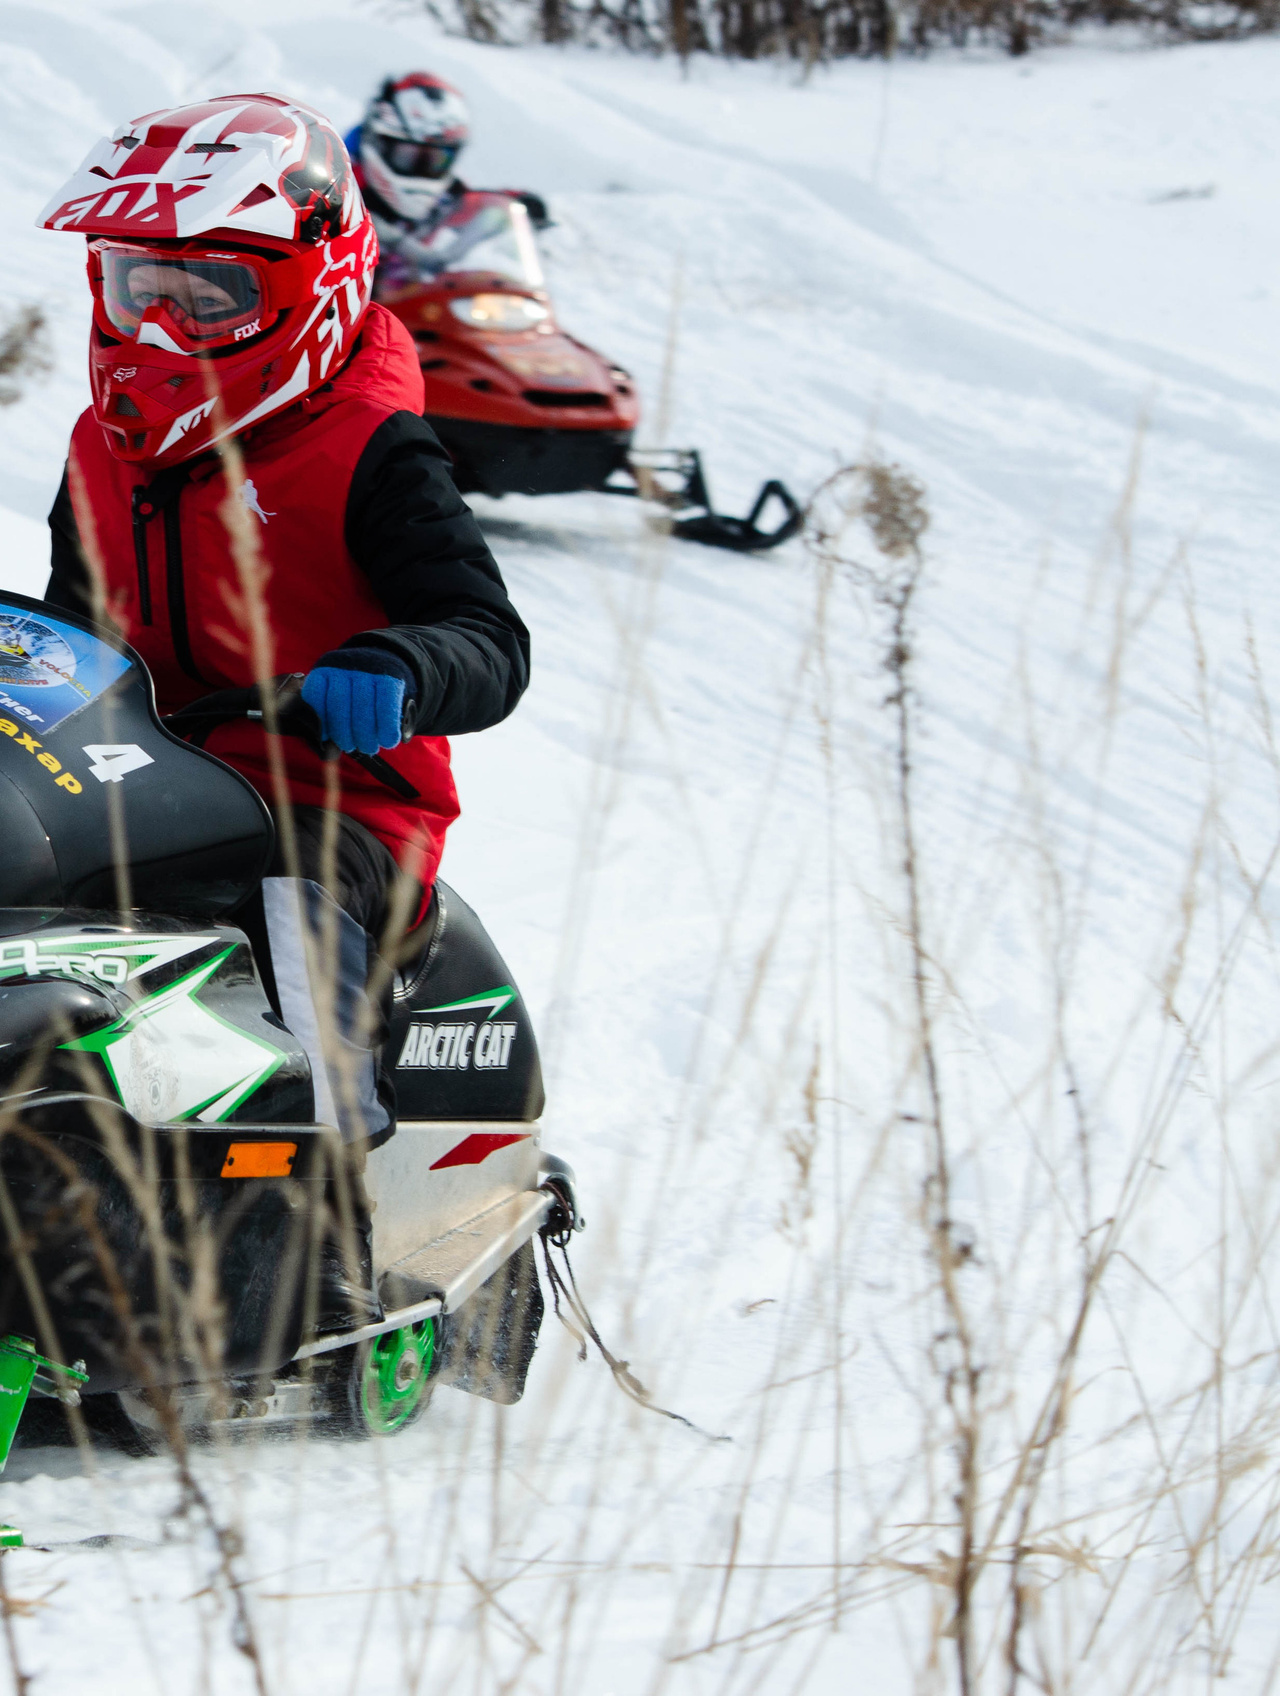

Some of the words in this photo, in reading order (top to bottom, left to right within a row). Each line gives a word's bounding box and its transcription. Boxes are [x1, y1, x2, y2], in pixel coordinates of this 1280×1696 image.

[44, 182, 207, 238] FOX
[234, 318, 261, 341] FOX
[81, 743, 155, 783] 4
[396, 1022, 477, 1070] ARCTIC
[473, 1021, 518, 1070] CAT
